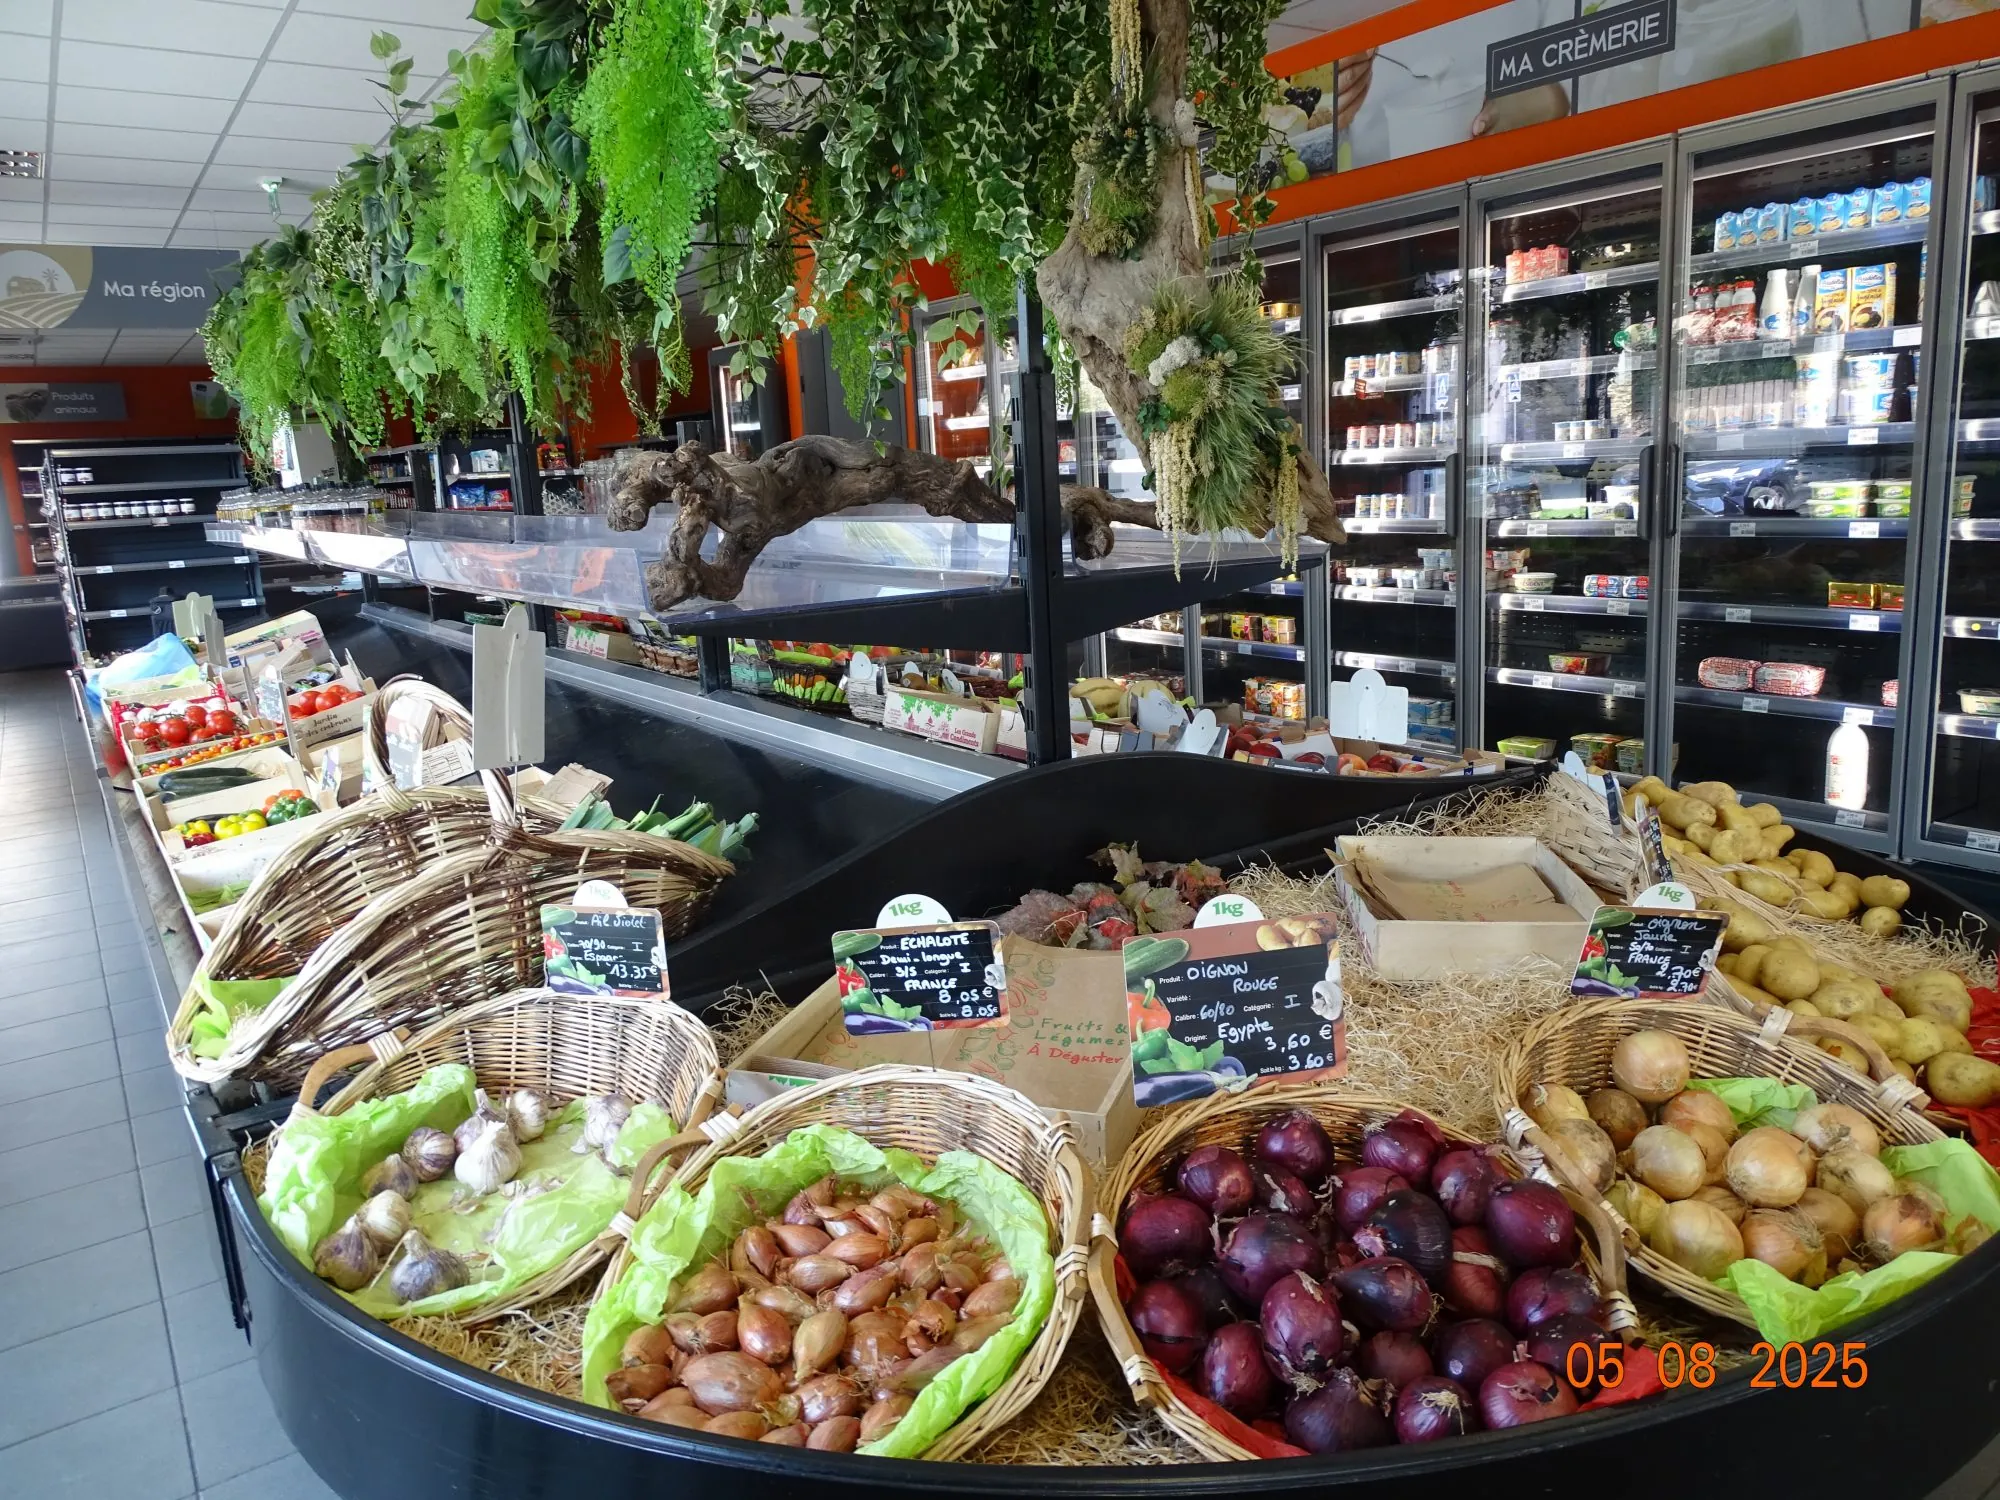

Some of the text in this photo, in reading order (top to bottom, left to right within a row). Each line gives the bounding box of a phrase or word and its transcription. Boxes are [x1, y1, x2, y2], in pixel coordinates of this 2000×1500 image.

[1500, 12, 1660, 81] MA CRÈMERIE
[104, 281, 206, 302] Ma région
[52, 391, 95, 401] Produits
[312, 713, 338, 727] Jardin
[950, 733, 979, 748] Condiments
[1658, 885, 1685, 902] 1kg
[889, 901, 923, 917] 1kg
[1212, 901, 1244, 917] 1kg
[591, 913, 609, 927] Ail
[900, 932, 970, 951] ECHALOTE
[1634, 930, 1678, 942] Jaune
[631, 941, 644, 952] I
[1627, 952, 1671, 965] FRANCE
[959, 962, 971, 973] I
[904, 977, 958, 991] FRANCE
[1233, 976, 1279, 994] ROUGE
[938, 986, 993, 1005] 8,05 €
[1200, 1000, 1235, 1023] 60/80
[1283, 994, 1301, 1009] I
[1041, 1017, 1129, 1034] Fruits &
[1218, 1017, 1274, 1044] Egypte
[1034, 1030, 1125, 1047] Légumes
[1264, 1024, 1333, 1053] 3,60 €
[1027, 1042, 1124, 1065] À Déguster
[1326, 1052, 1334, 1062] €
